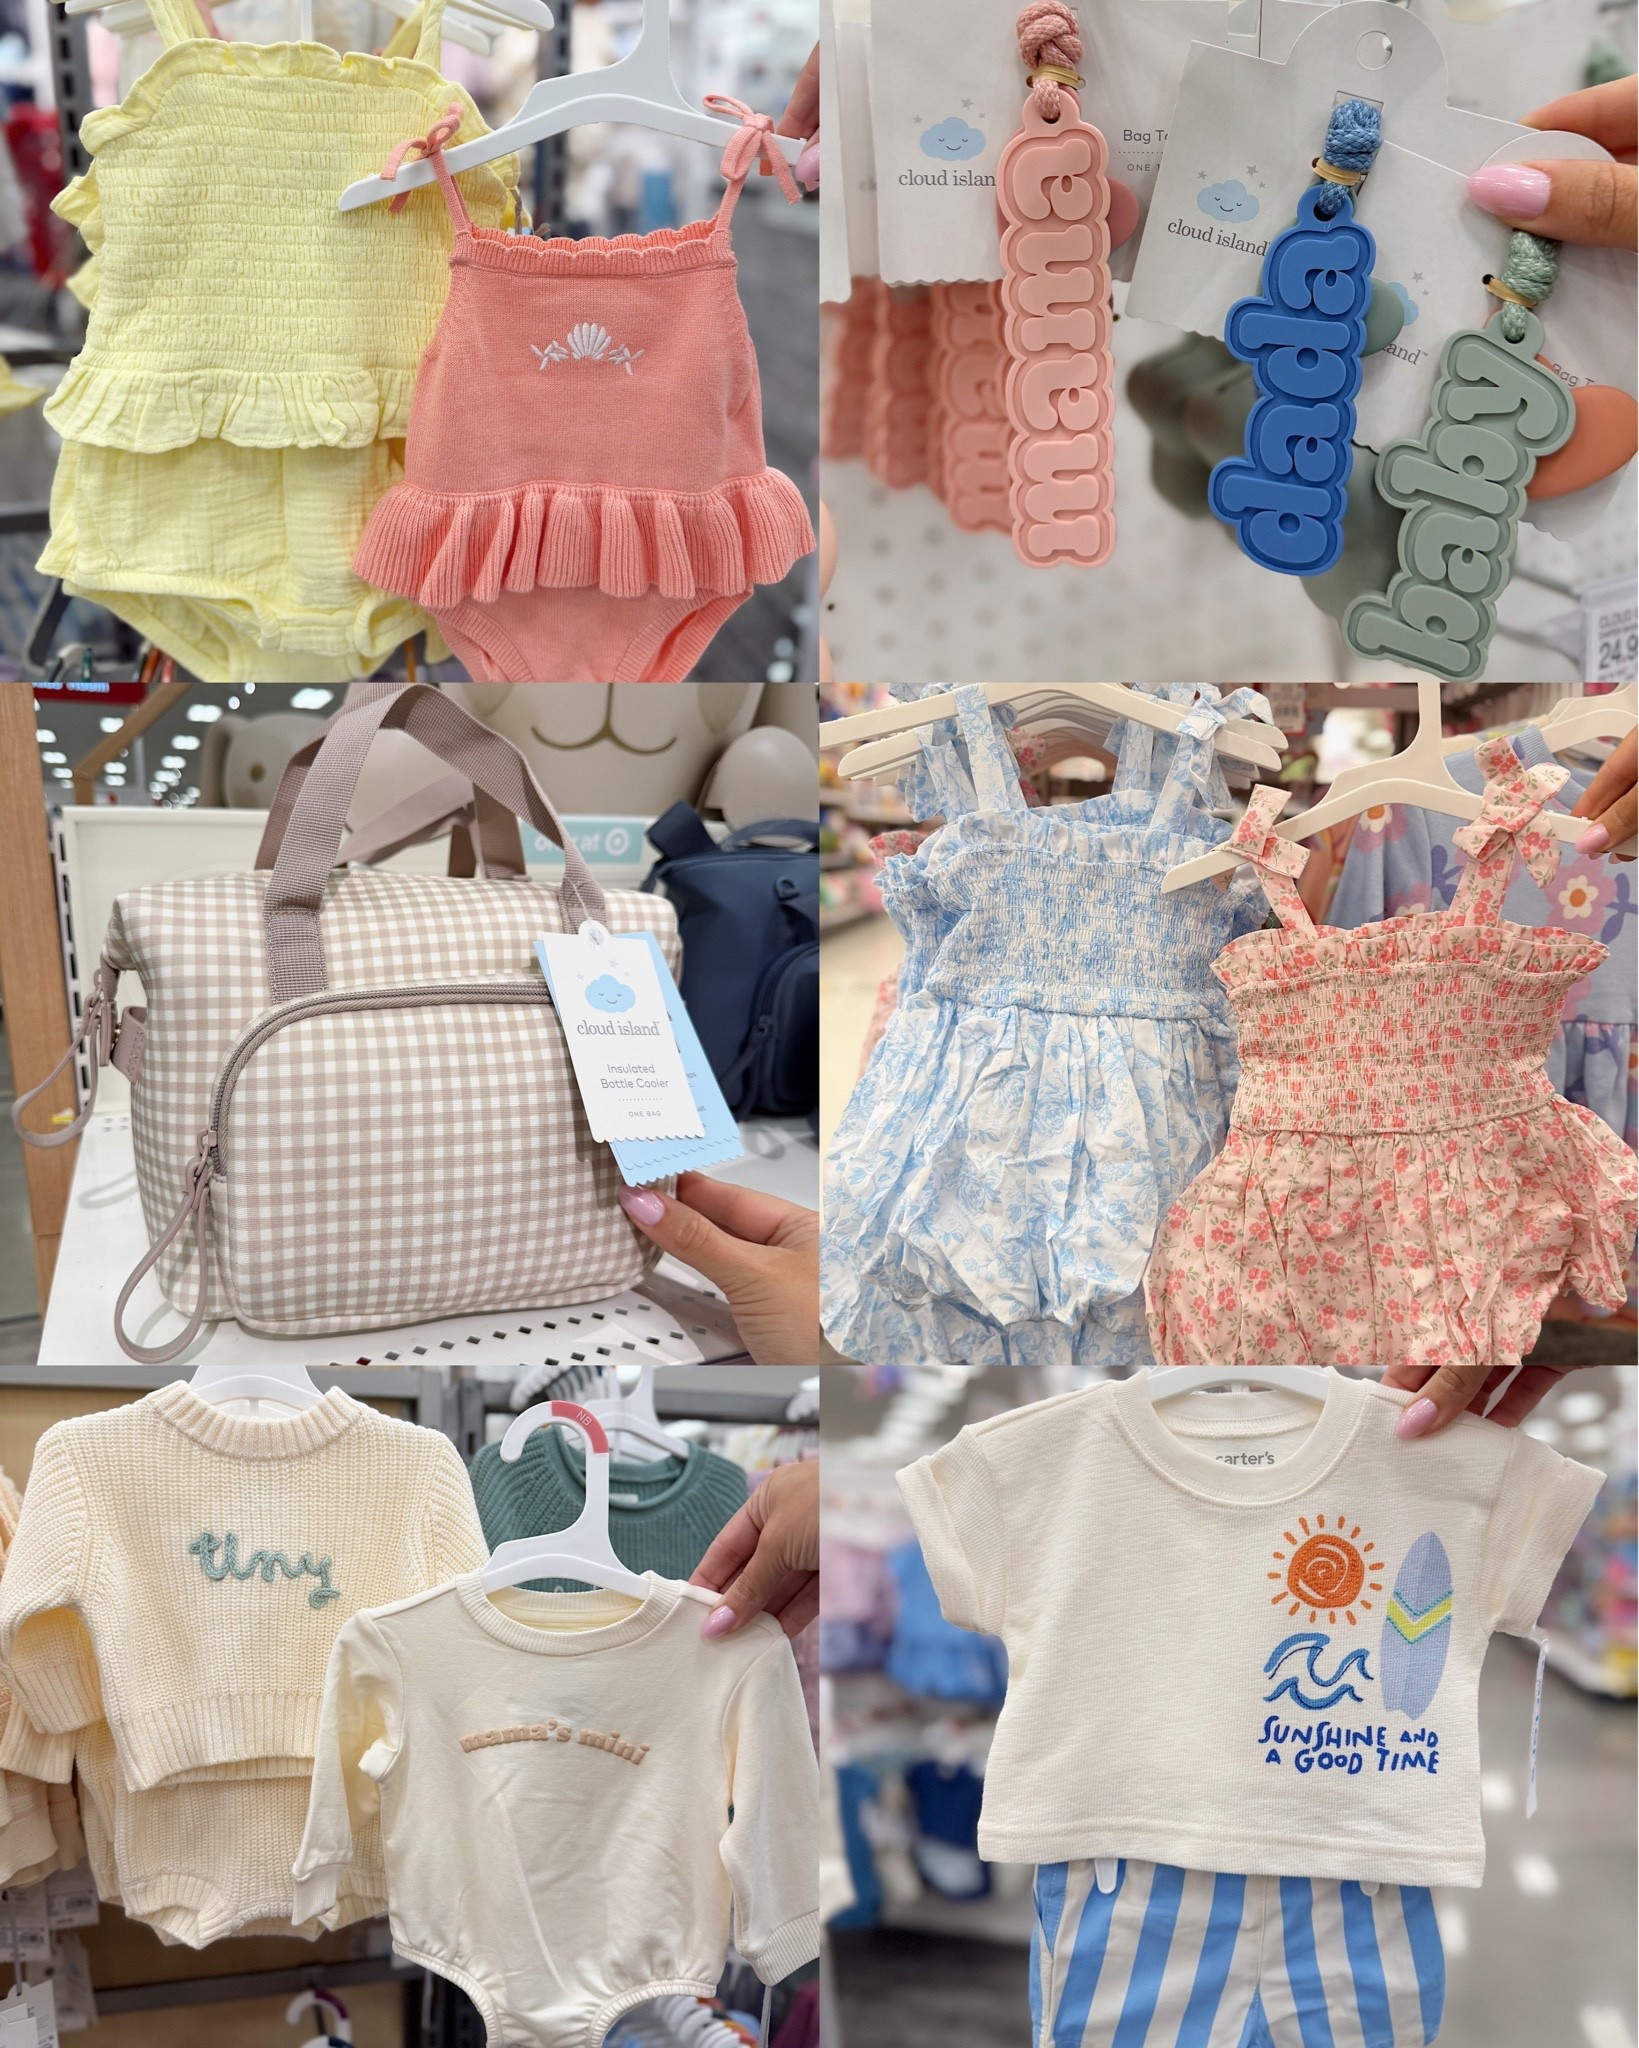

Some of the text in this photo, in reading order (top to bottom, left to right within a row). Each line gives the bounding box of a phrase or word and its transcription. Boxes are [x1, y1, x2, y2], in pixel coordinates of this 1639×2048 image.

[1123, 129, 1151, 145] Bag
[899, 169, 948, 187] cloud
[952, 169, 997, 187] islan
[1127, 163, 1151, 172] ONE
[1167, 218, 1214, 243] cloud
[1012, 138, 1101, 558] mama
[1221, 235, 1360, 564] dada
[1355, 342, 1558, 673] baby
[576, 1020, 617, 1036] cloud
[606, 1063, 656, 1074] Insulated
[600, 1078, 669, 1089] Bottle Cooler
[628, 1110, 644, 1118] ONE
[575, 1410, 593, 1427] NB
[189, 1528, 342, 1610] tiny
[459, 1717, 651, 1766] mama's mini
[1257, 1715, 1440, 1753] SUNSHINE AND
[1265, 1747, 1440, 1775] A GOOD TIME
